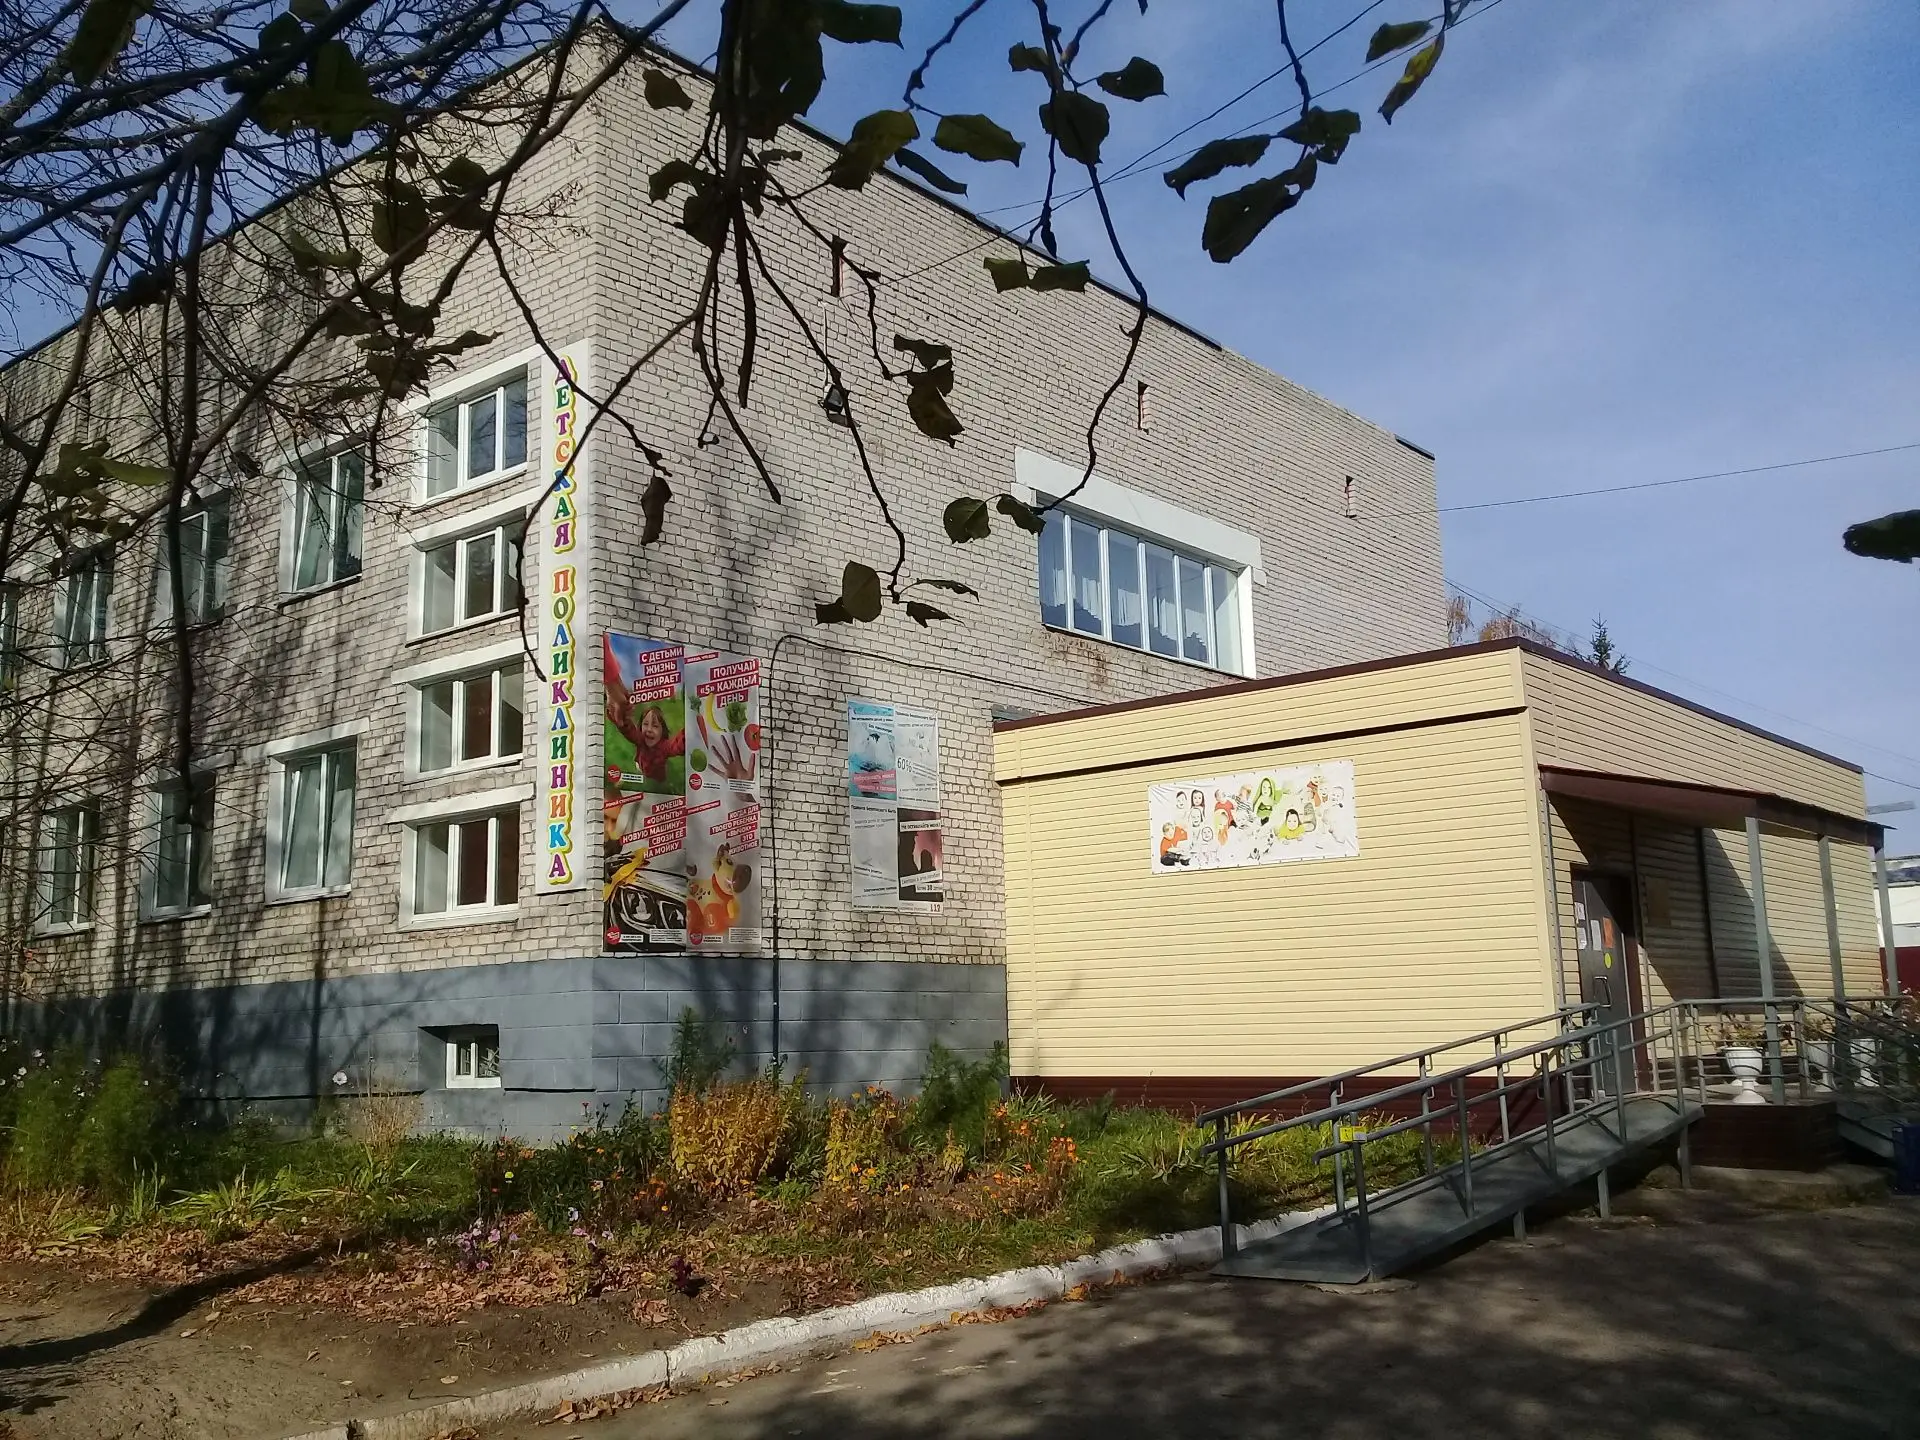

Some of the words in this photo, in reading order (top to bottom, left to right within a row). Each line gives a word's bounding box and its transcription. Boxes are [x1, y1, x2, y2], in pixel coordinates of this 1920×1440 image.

[641, 653, 648, 663] С
[648, 647, 683, 663] ДЕТЬМИ
[646, 661, 676, 675] ЖИЗНЬ
[635, 673, 680, 690] НАБИРАЕТ
[629, 687, 671, 705] ОБОРОТЫ
[720, 692, 745, 708] ДЕНЬ
[549, 568, 570, 879] ПОЛИКЛИНИКА
[655, 798, 684, 812] ХОЧЕШЬ
[711, 821, 733, 834] ТВОЕГО
[622, 831, 649, 844] НОВУЮ
[651, 832, 675, 845] СВОЗИ
[742, 832, 754, 842] ЭТО
[643, 850, 653, 859] НА
[654, 841, 680, 856] МОЙКУ
